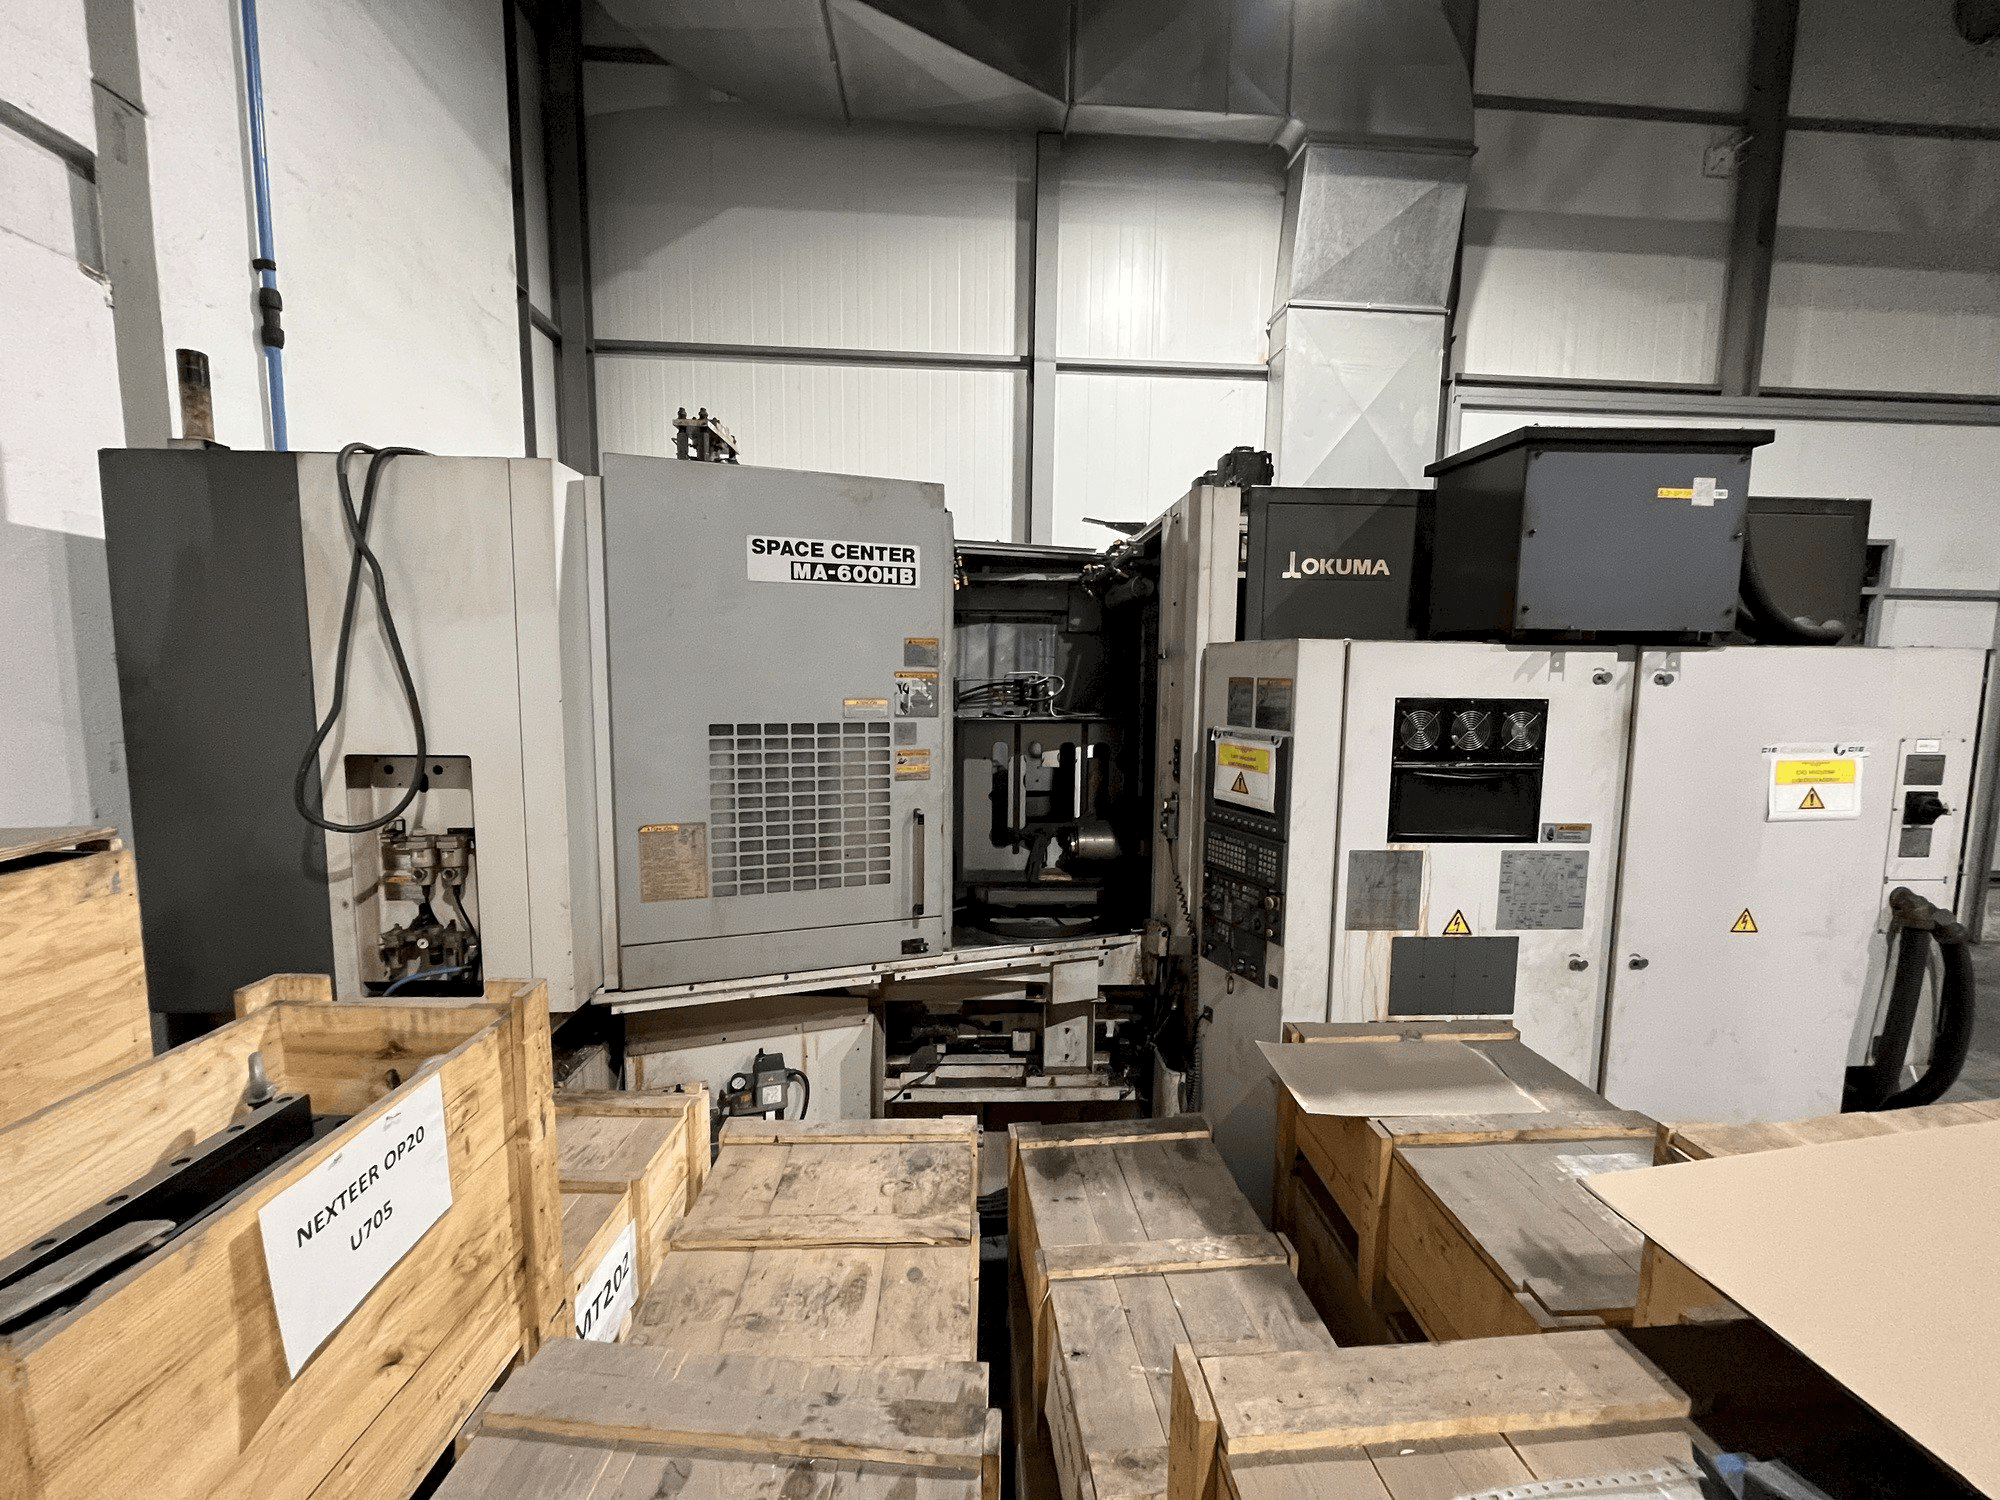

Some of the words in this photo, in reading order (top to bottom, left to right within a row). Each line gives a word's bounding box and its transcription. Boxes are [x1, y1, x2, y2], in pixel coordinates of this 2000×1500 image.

[751, 538, 824, 559] SPACE
[830, 543, 916, 563] CENTER
[792, 562, 914, 585] MA-600HB
[1301, 558, 1391, 576] OKUMA
[297, 1164, 380, 1248] NEXTEER
[384, 1125, 425, 1170] OP20
[350, 1199, 393, 1251] U705
